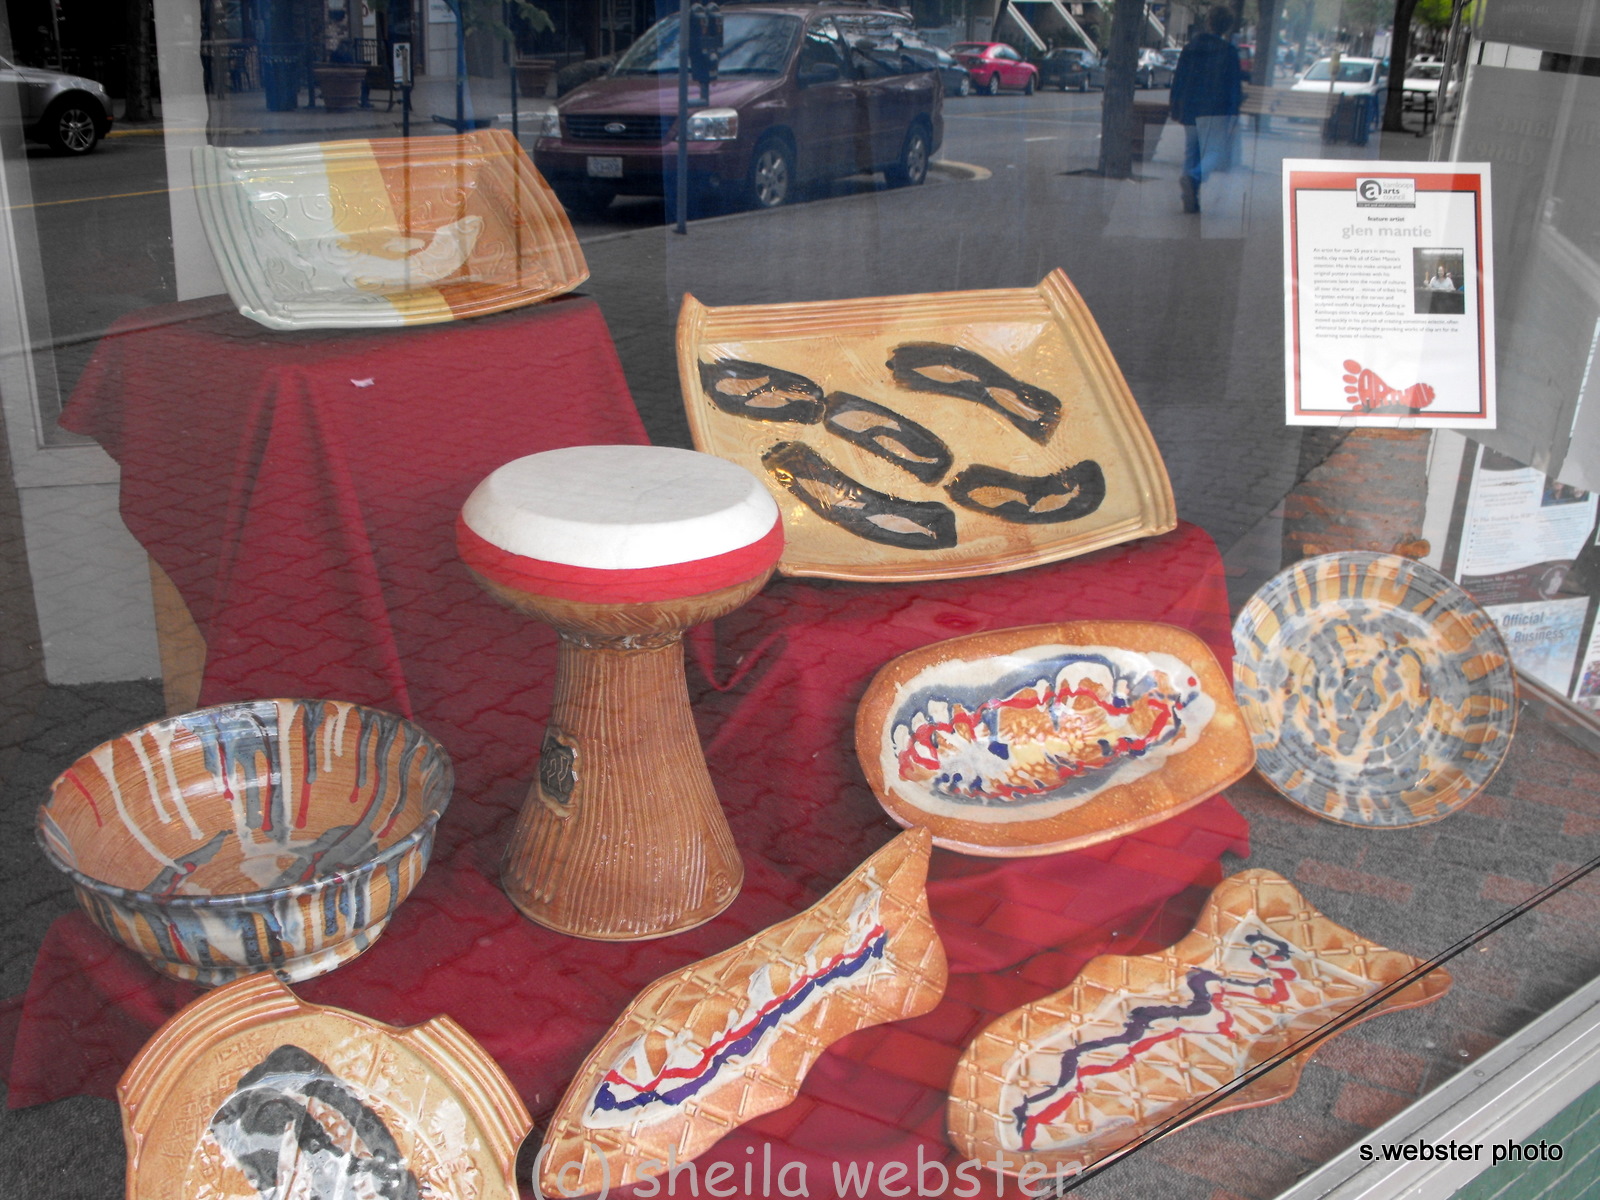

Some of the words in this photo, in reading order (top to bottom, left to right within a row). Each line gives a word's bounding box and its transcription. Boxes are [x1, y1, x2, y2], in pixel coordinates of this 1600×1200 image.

[1342, 224, 1373, 239] glen
[1378, 225, 1432, 237] mantie
[1502, 611, 1545, 627] Official
[1514, 628, 1565, 643] Business
